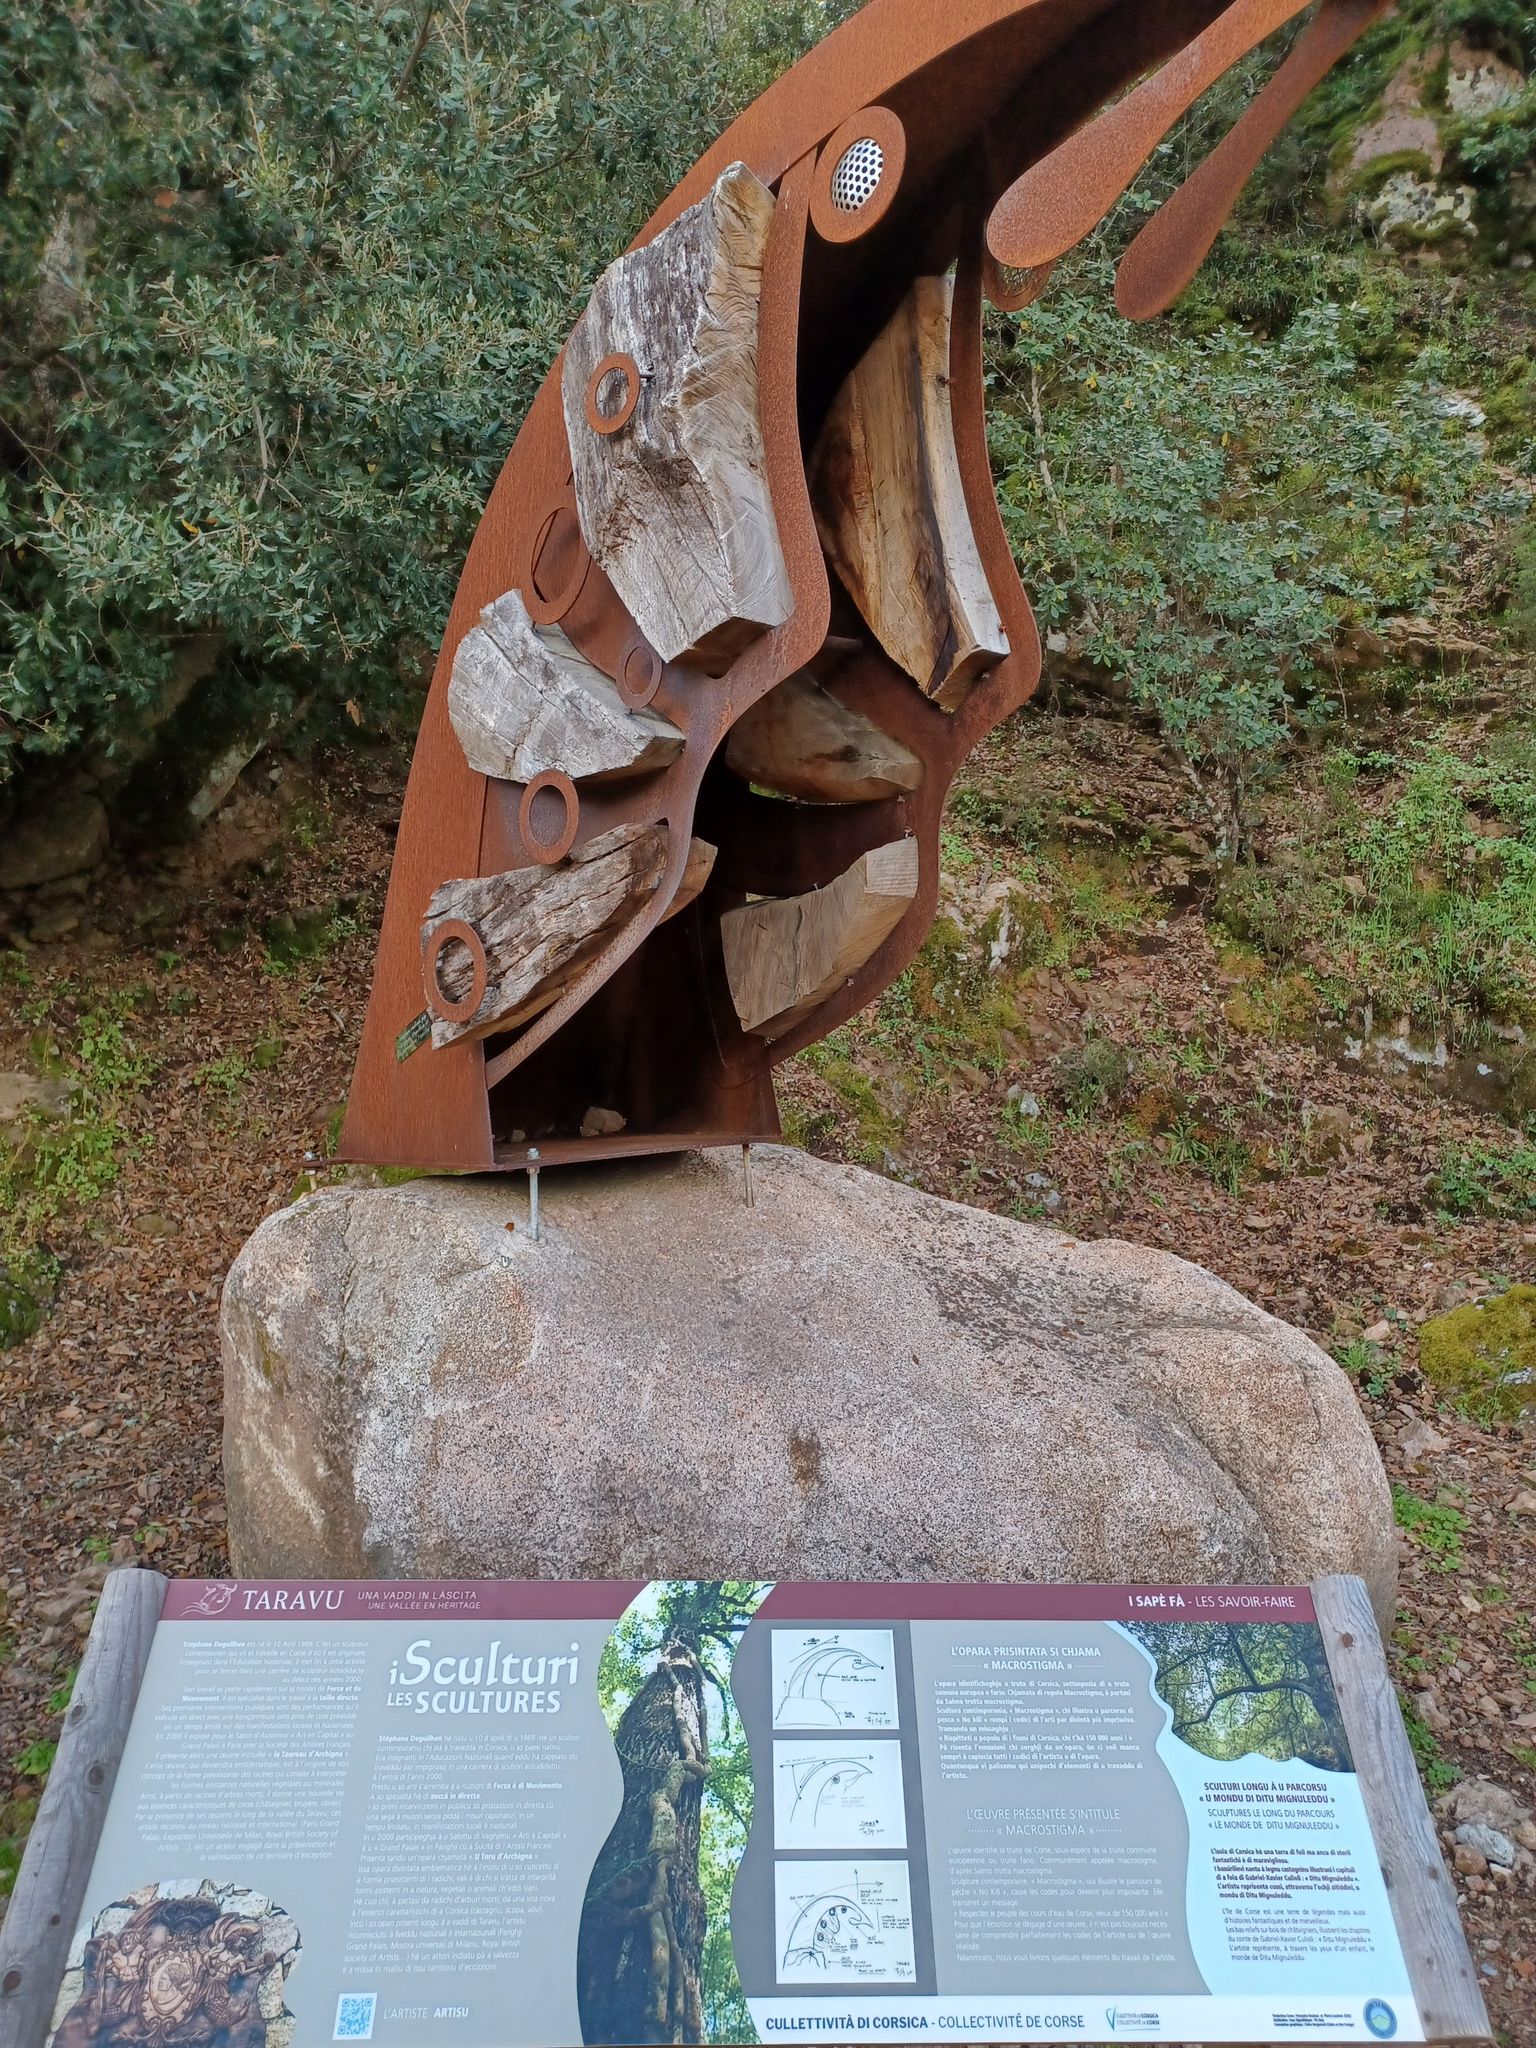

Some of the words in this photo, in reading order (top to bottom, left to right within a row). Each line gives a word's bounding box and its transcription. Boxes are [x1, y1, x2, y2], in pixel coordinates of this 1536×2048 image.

[242, 1590, 345, 1609] TARAVU
[432, 1590, 477, 1599] LÀSCITA
[1128, 1596, 1133, 1606] I
[1136, 1594, 1166, 1607] SAPÈ
[1170, 1594, 1185, 1608] FÀ
[1195, 1596, 1215, 1608] LES
[1219, 1596, 1296, 1608] SAVOIR-FAIRE
[952, 1646, 990, 1655] L'OPARA
[994, 1647, 1047, 1655] PRISINTATA
[1050, 1647, 1058, 1655] SI
[1061, 1647, 1101, 1656] CHJAMA
[991, 1660, 1064, 1669] MACROSTIGMA
[386, 1692, 412, 1706] LES
[415, 1690, 561, 1714] SCULTURES
[1271, 1781, 1277, 1790] À
[966, 1808, 1010, 1820] L'ŒUVRE
[1013, 1808, 1066, 1820] PRÉSENTÉE
[1070, 1808, 1120, 1820] S'INTITULE
[1208, 1808, 1251, 1816] SCULPTURES
[1252, 1808, 1260, 1817] LE
[1006, 1824, 1085, 1835] MACROSTIGMA
[1214, 1820, 1222, 1828] LE
[384, 2008, 428, 2020] L'ARTISTE
[434, 2006, 469, 2018] ARTISU
[766, 2014, 855, 2030] CULLETTIVITÀ
[858, 2016, 870, 2029] DI
[872, 2016, 928, 2029] CORSICA
[938, 2013, 1024, 2028] COLLECTIVITÉ
[1026, 2016, 1042, 2028] DE
[1044, 2016, 1085, 2028] CORSE
